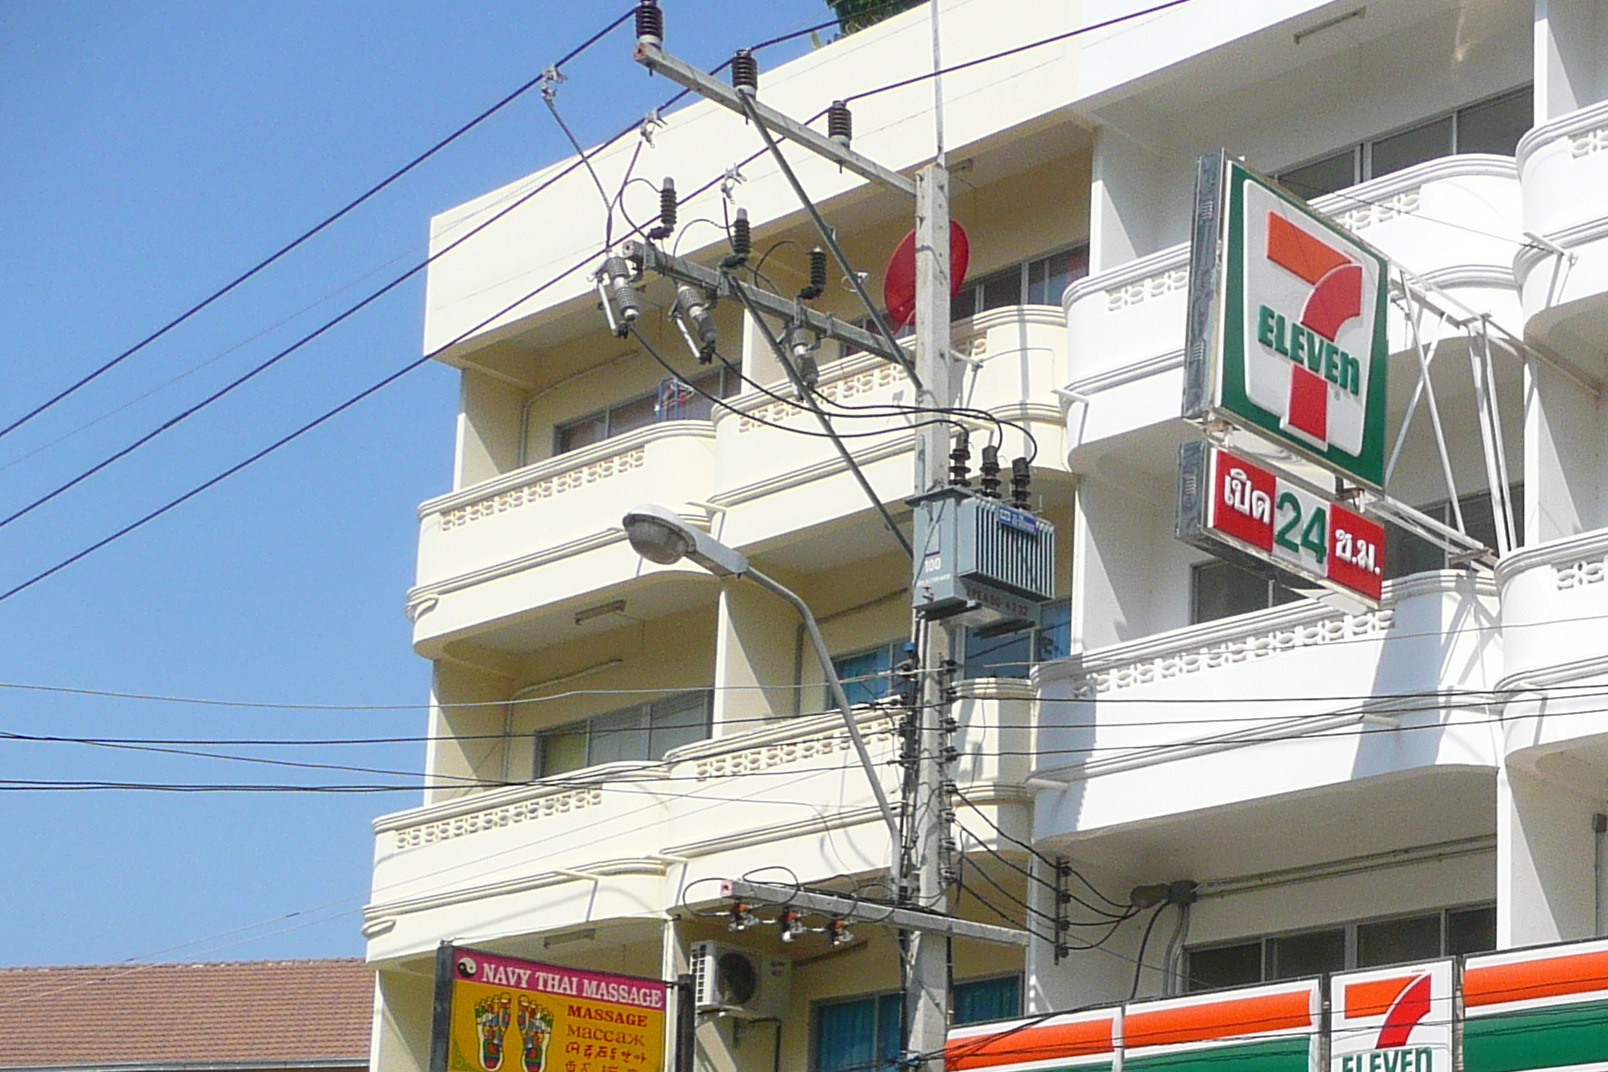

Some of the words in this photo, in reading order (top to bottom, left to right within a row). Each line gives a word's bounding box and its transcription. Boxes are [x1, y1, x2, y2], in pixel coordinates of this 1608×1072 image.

[1224, 468, 1271, 525] เปิด
[1275, 491, 1327, 564] 24
[481, 963, 532, 989] NAVY
[535, 972, 578, 996] THAI
[582, 979, 663, 1009] MASSAGE
[567, 1005, 648, 1028] MASSAGE
[566, 1024, 647, 1048] Массаж
